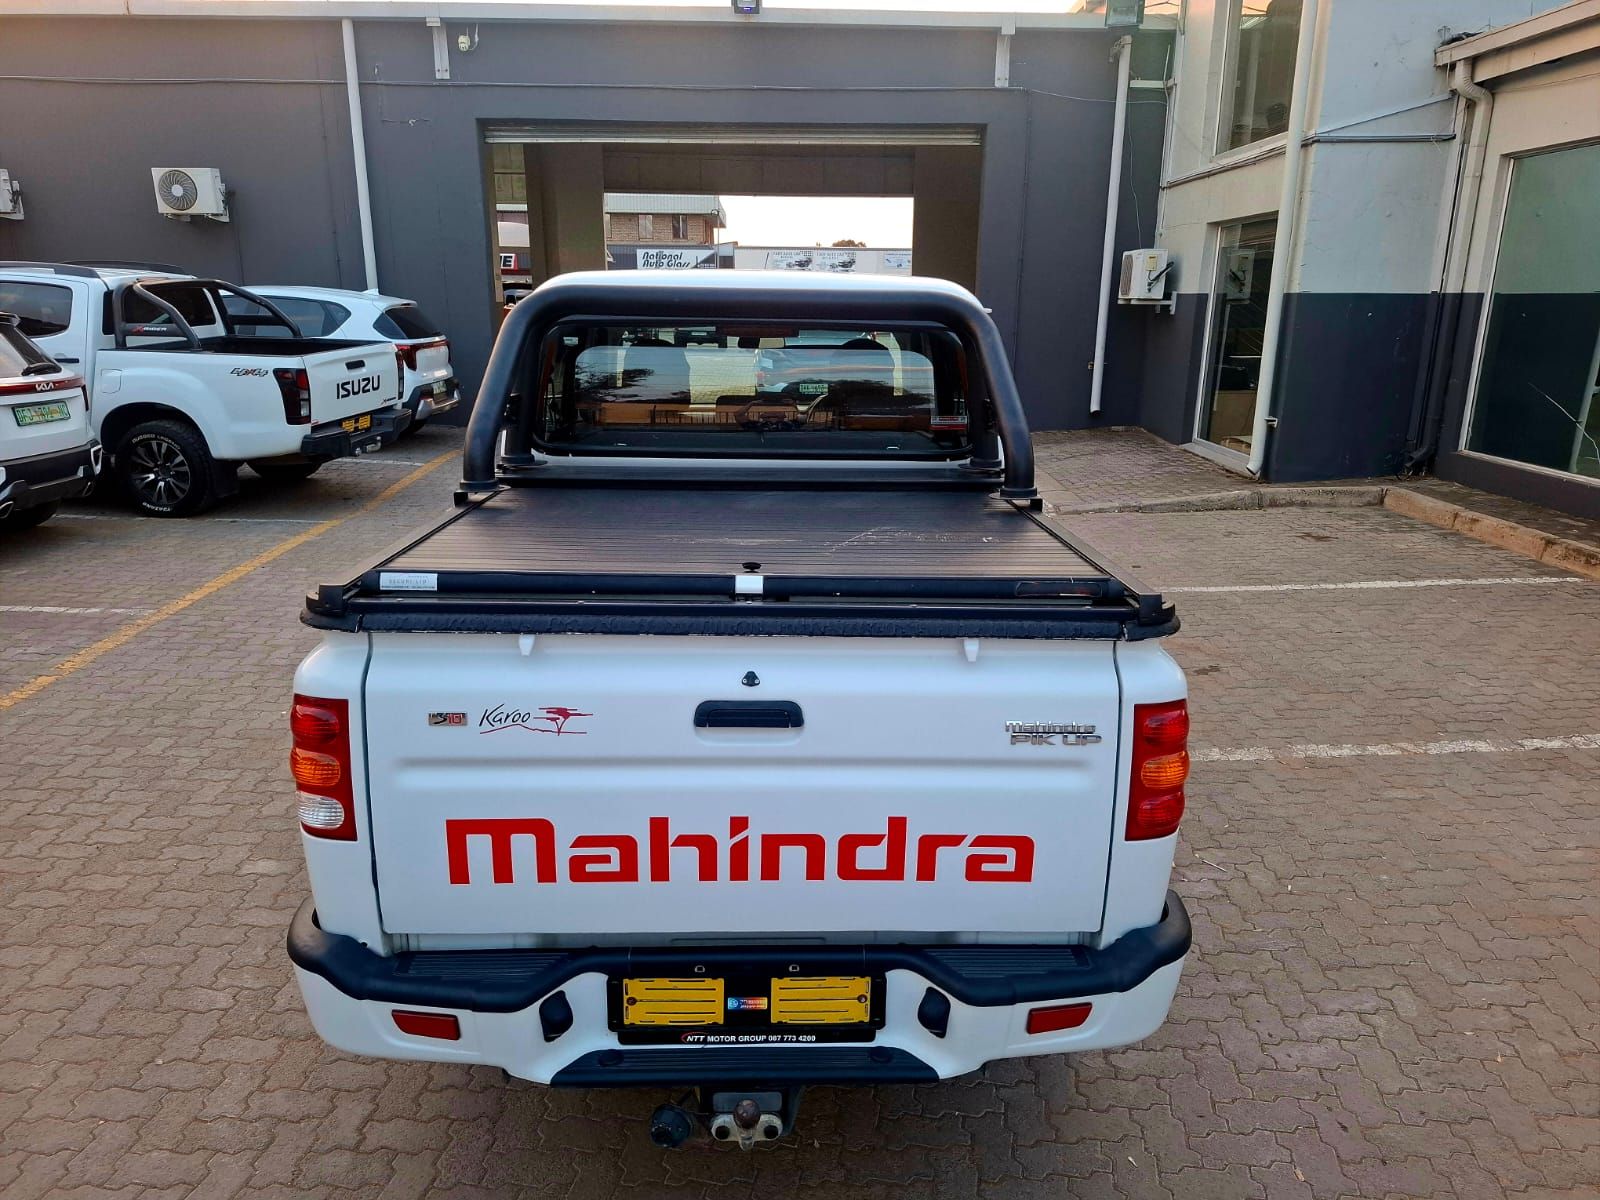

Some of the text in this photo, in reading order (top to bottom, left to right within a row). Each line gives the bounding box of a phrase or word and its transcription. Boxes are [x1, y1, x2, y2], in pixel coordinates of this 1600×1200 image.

[642, 251, 683, 260] National
[642, 260, 691, 268] Auto Glass
[35, 383, 54, 391] KIA
[336, 375, 381, 400] ISUZU
[479, 703, 531, 728] Karoo
[1010, 733, 1103, 746] PIK UP
[707, 1035, 737, 1043] MOTOR
[783, 1034, 797, 1042] 773
